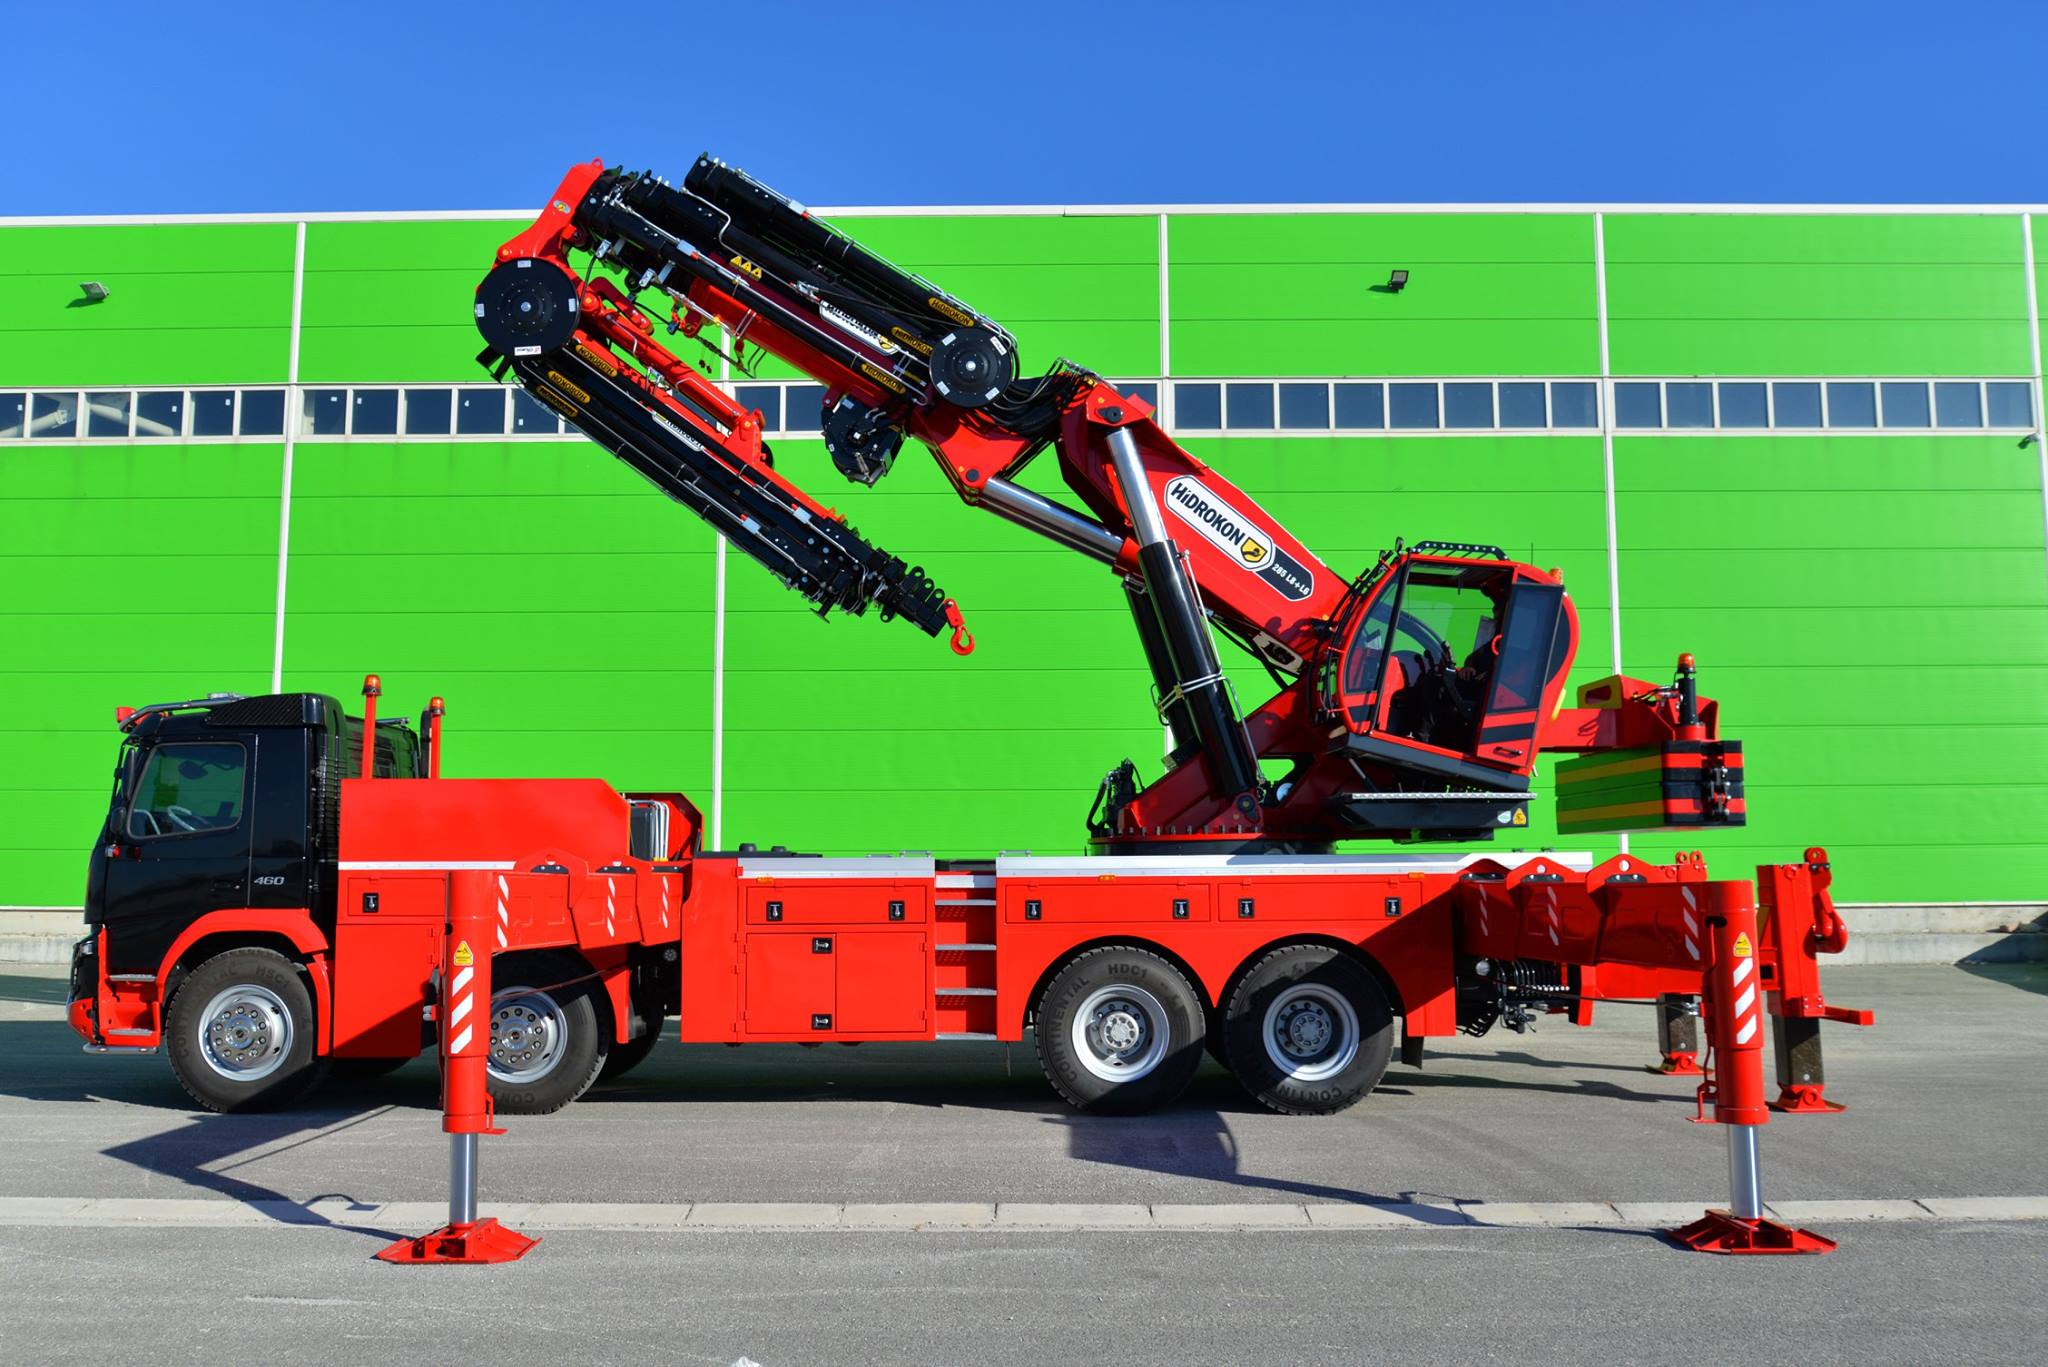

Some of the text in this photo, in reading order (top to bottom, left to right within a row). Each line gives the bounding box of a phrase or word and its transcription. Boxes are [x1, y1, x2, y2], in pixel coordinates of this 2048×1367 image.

[1271, 562, 1288, 578] 285
[253, 876, 286, 886] 460
[1108, 963, 1149, 979] HDC1
[1050, 975, 1090, 1082] CONTINENTAL
[1277, 1083, 1344, 1102] CONTIN
